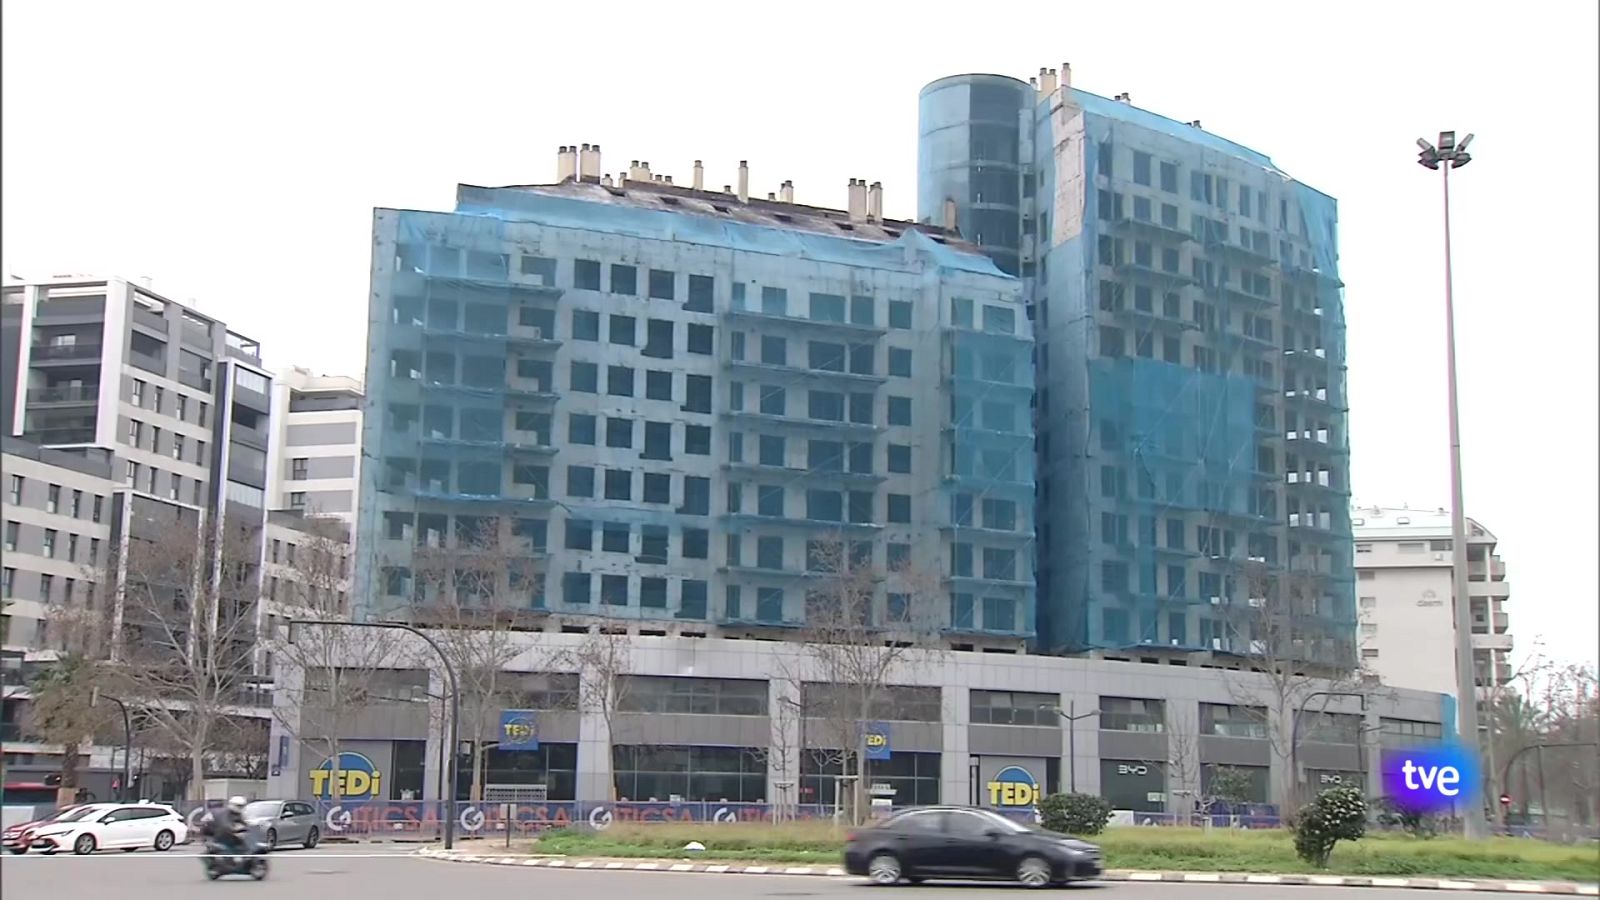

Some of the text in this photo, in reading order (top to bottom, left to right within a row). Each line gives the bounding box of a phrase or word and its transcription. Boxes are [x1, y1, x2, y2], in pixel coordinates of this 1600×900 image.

[1118, 764, 1148, 775] BYD
[309, 769, 381, 796] TEDi
[987, 782, 1039, 806] TEDi
